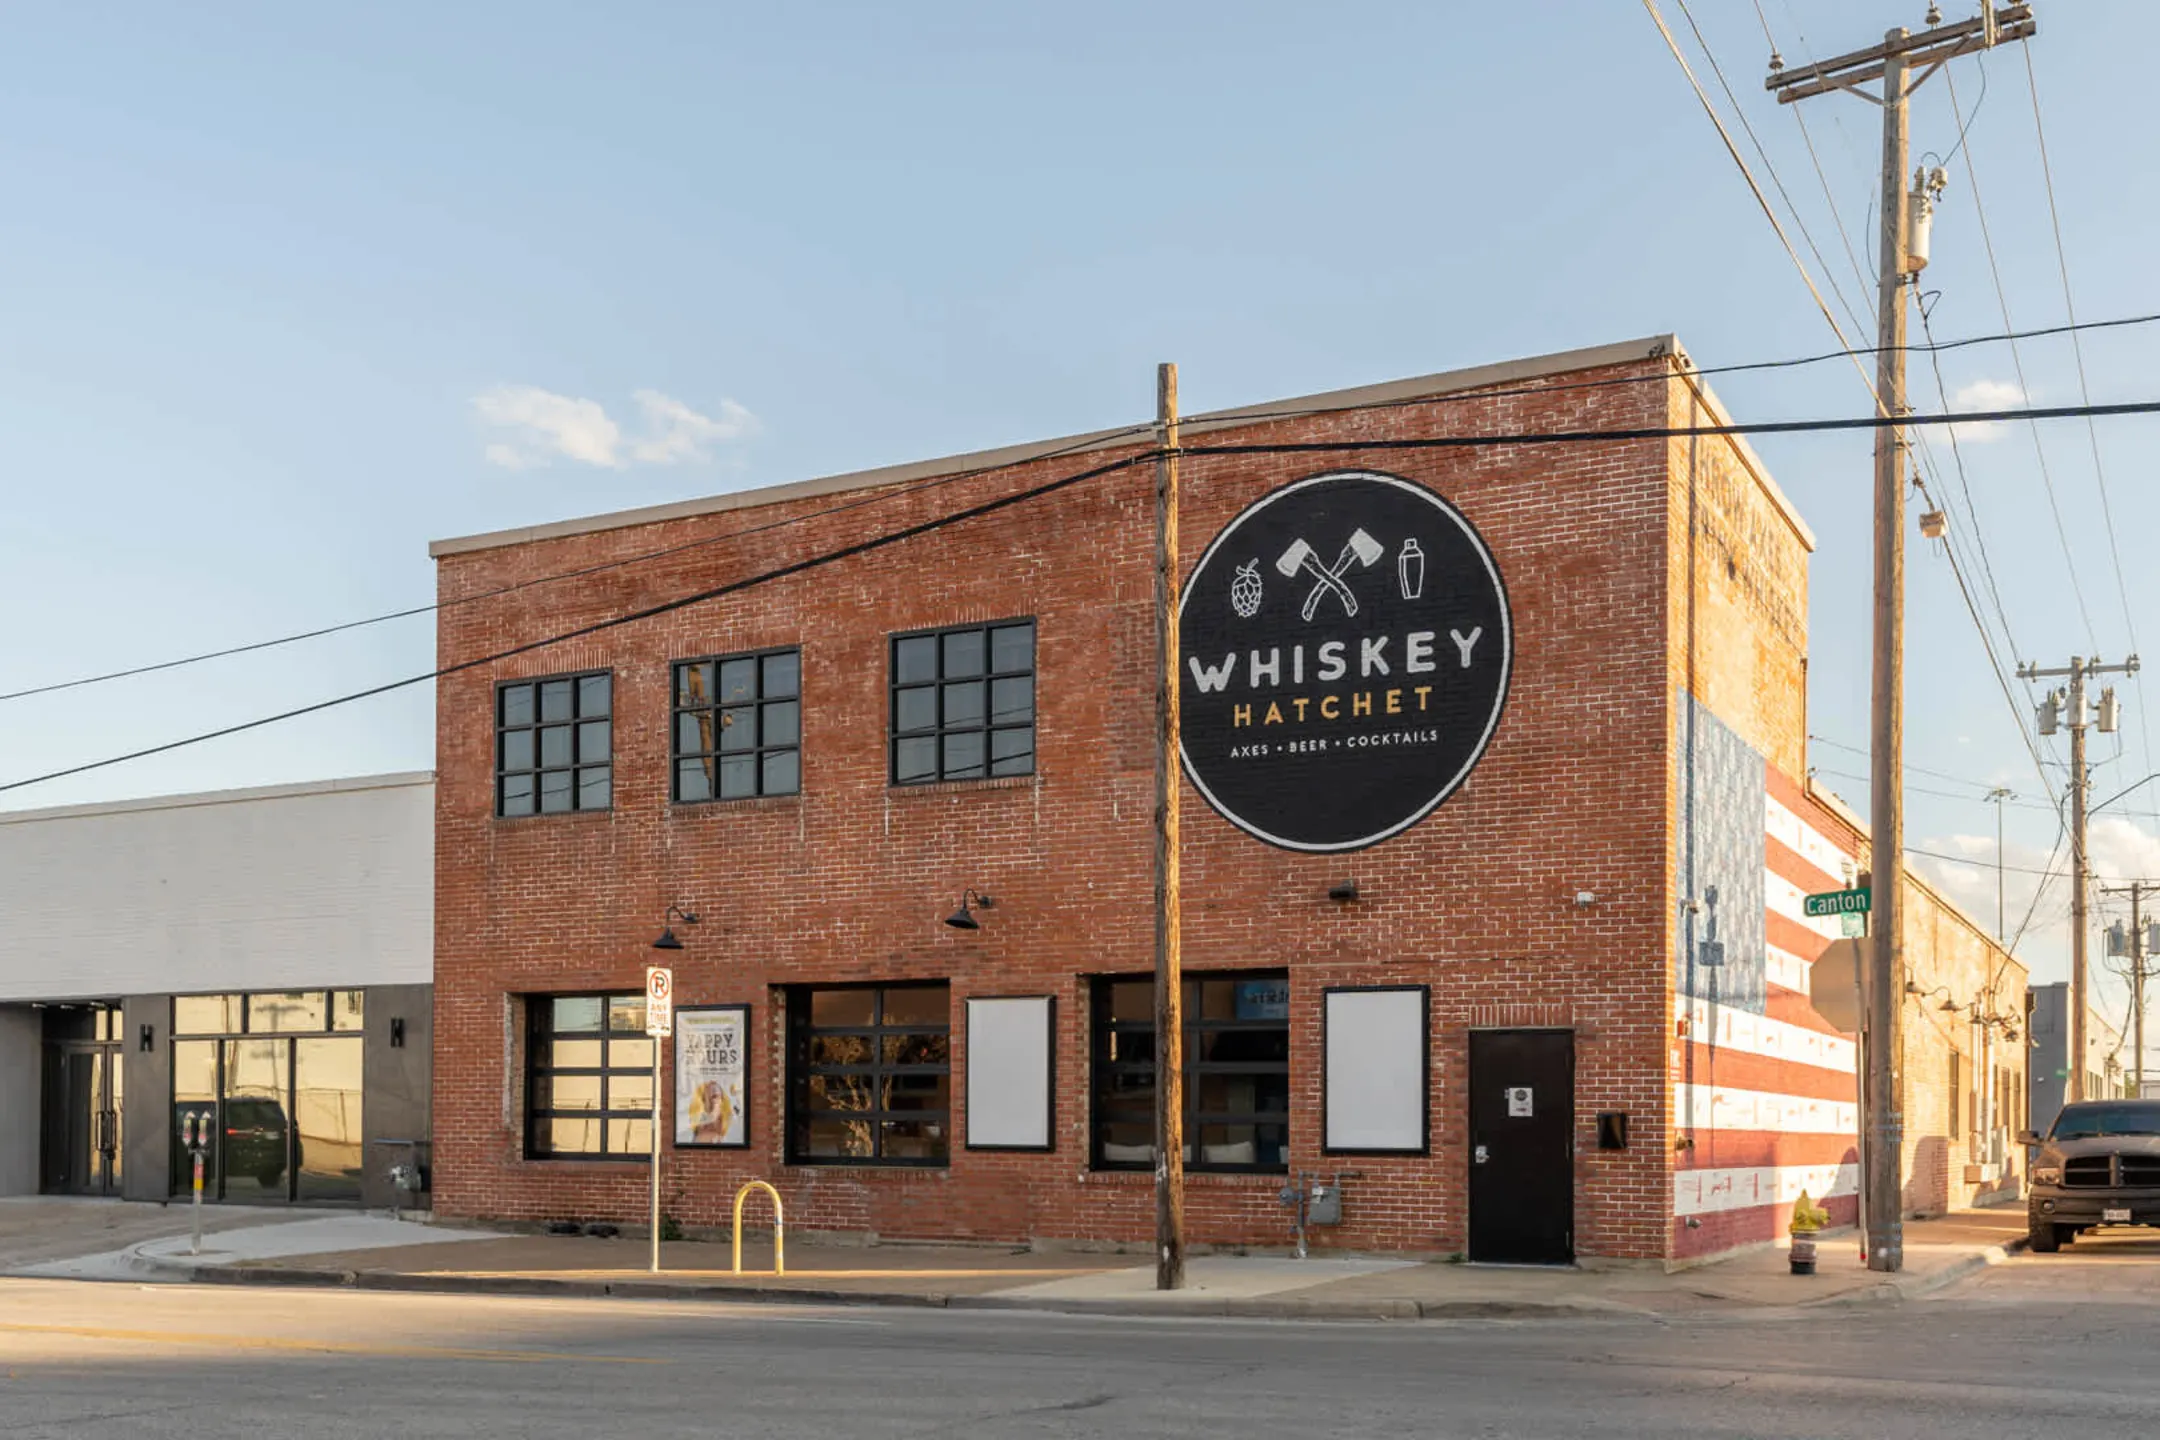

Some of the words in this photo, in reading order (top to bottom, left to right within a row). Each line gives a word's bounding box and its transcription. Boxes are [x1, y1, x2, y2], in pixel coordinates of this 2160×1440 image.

[1188, 626, 1484, 694] WHISKEY
[1232, 686, 1434, 728] HATCHET
[1230, 744, 1269, 758] AXES
[1289, 739, 1328, 753] BEER
[1346, 729, 1438, 748] COCKTAILS
[1806, 893, 1867, 914] Canton
